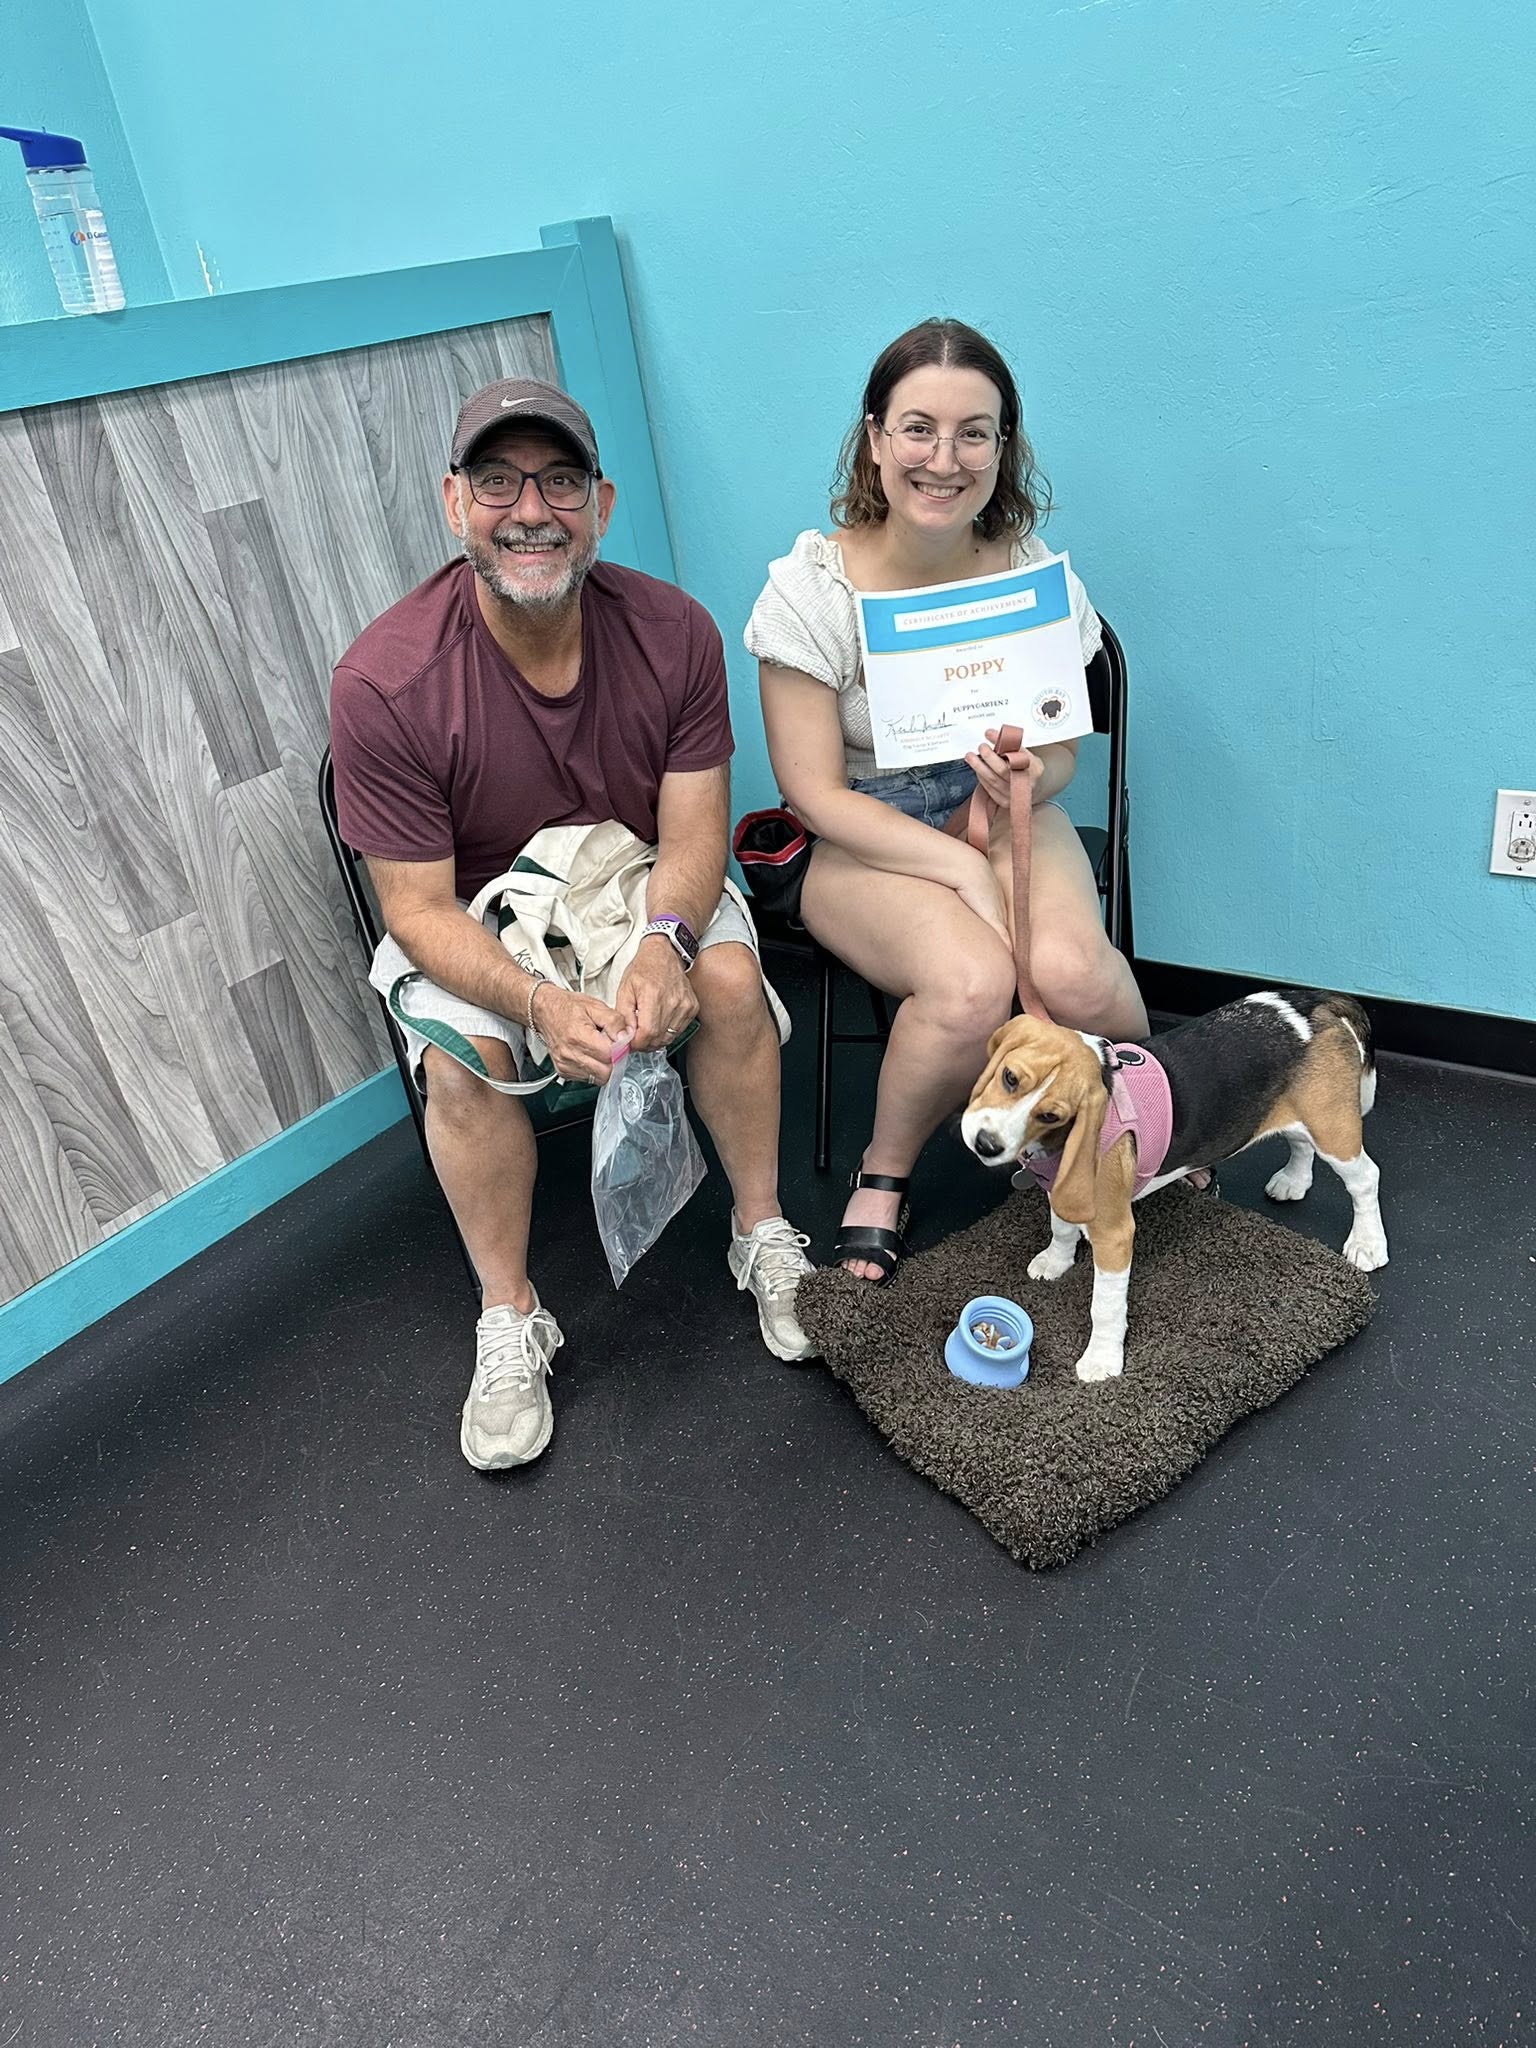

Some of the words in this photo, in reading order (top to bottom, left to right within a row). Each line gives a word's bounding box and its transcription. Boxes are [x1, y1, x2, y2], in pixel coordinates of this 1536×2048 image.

[903, 611, 955, 626] CERTIFICATE
[957, 608, 969, 617] OF
[969, 596, 1029, 615] ACHIEVEMENT
[943, 657, 1005, 682] POPPY
[952, 700, 1004, 713] PUPPYGARTEN
